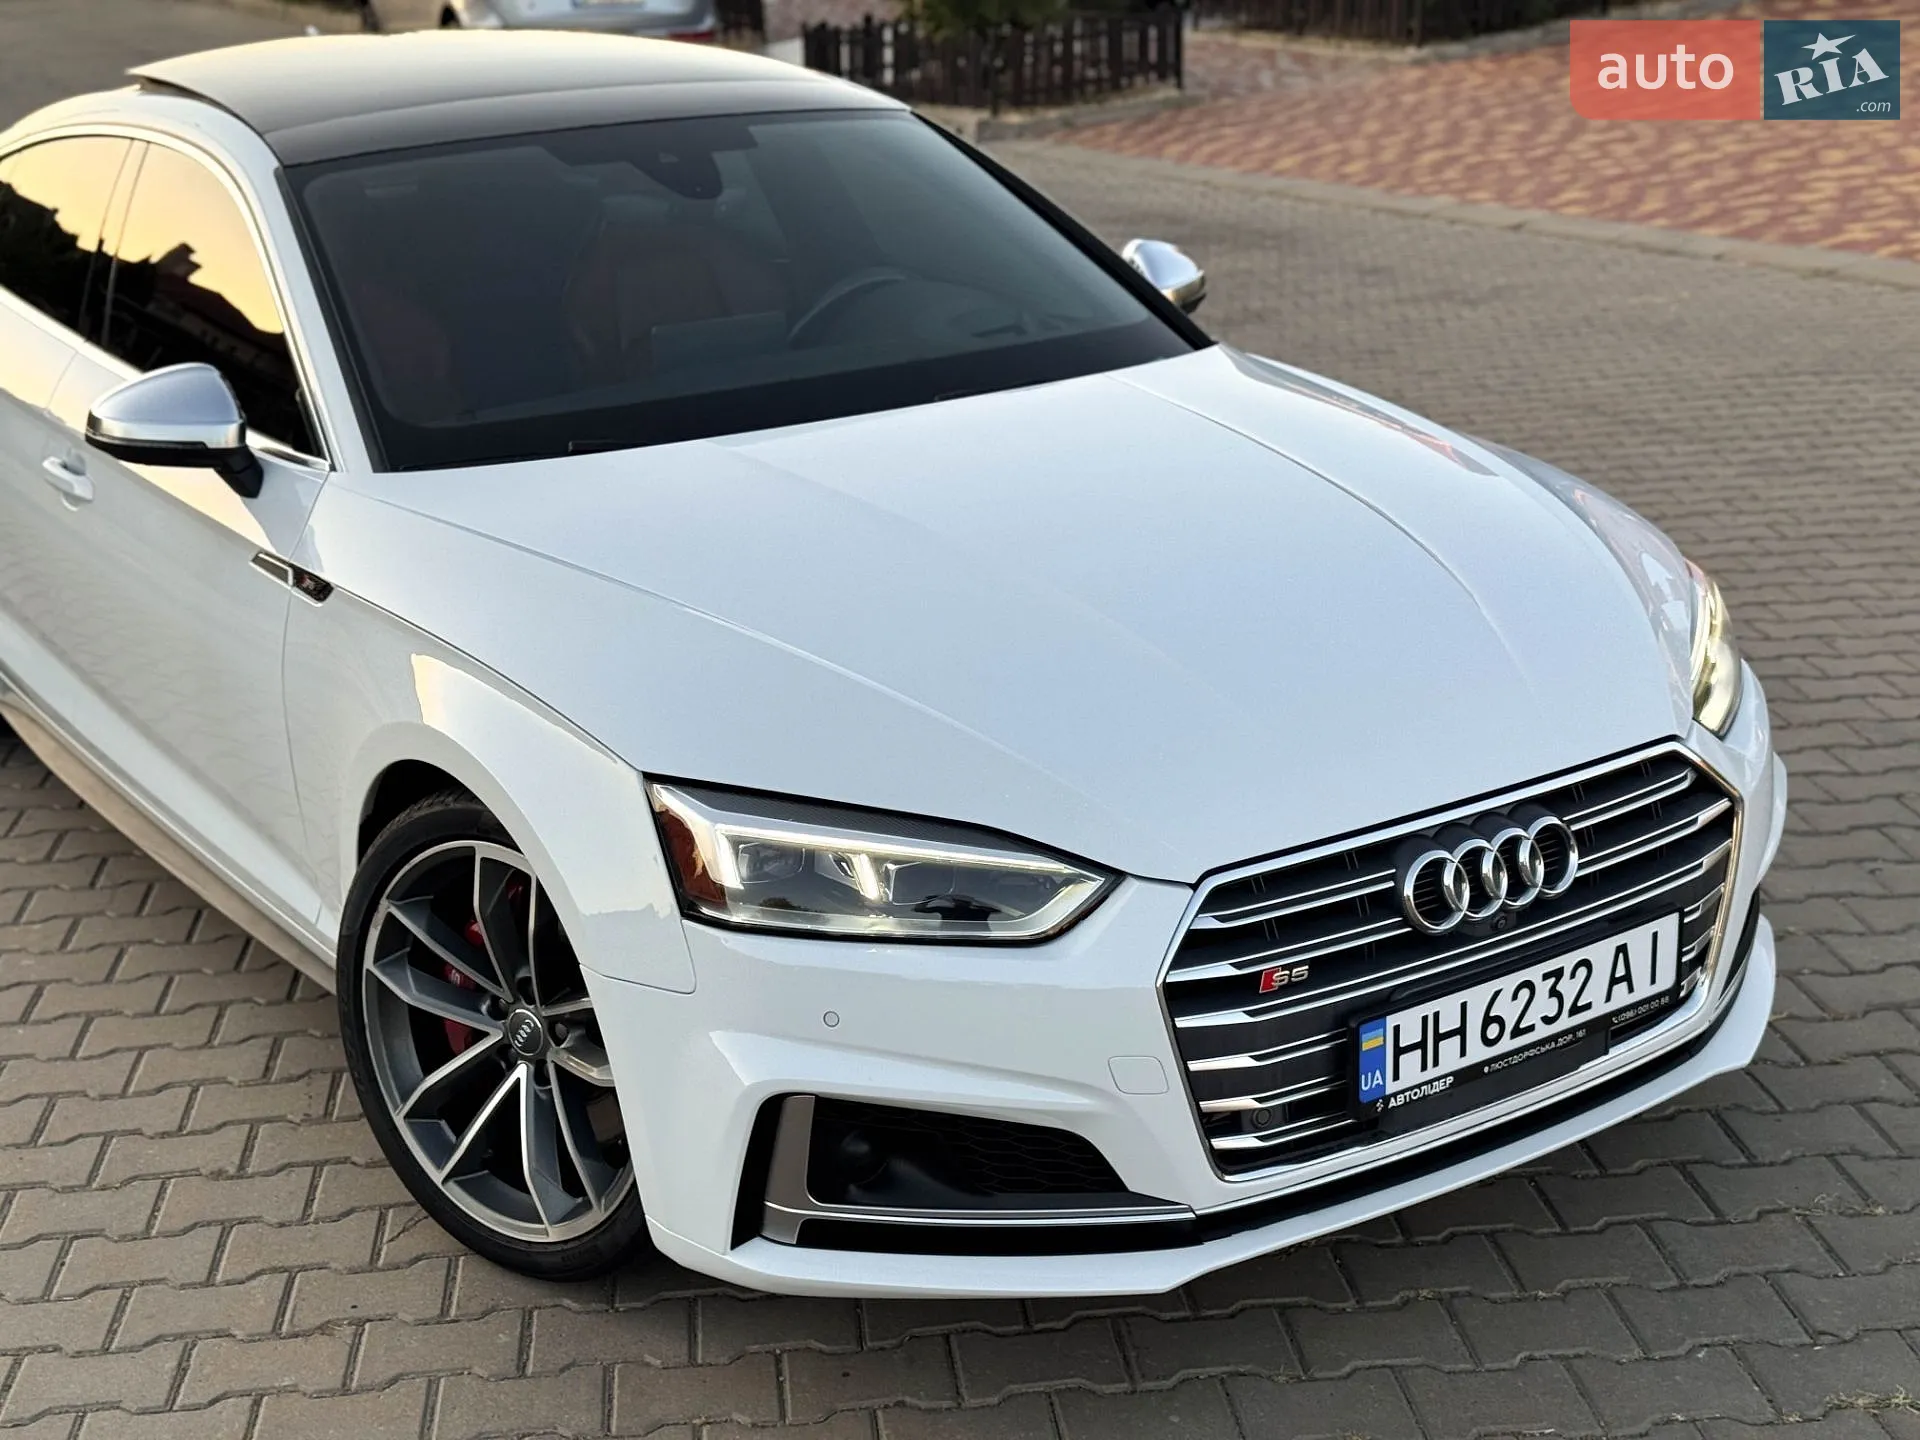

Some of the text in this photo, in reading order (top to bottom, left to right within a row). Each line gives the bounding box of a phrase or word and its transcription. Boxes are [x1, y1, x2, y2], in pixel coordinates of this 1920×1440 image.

[1270, 965, 1309, 987] S5
[1391, 1000, 1468, 1083] HH
[1480, 958, 1594, 1048] 6232
[1361, 1069, 1384, 1091] UA
[1388, 1075, 1455, 1109] АВТОЛІДЕР
